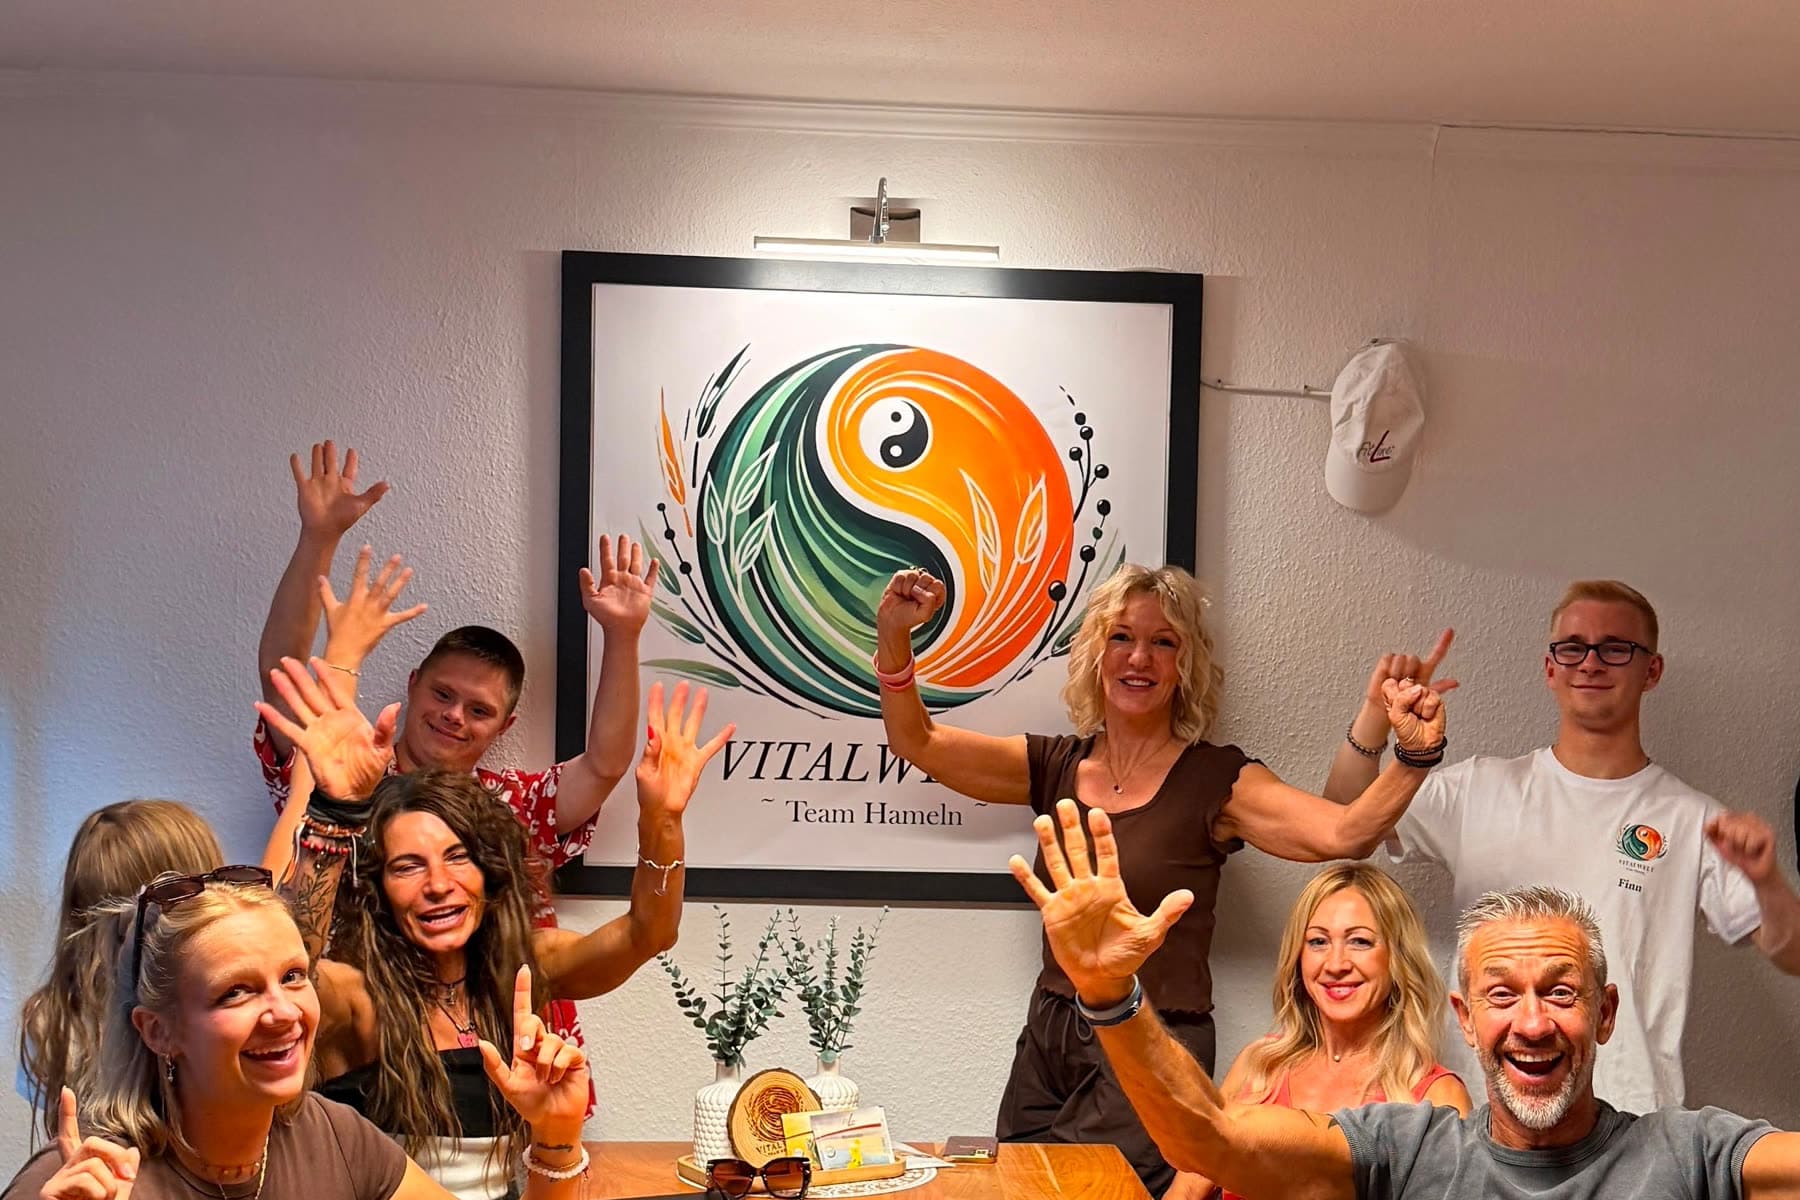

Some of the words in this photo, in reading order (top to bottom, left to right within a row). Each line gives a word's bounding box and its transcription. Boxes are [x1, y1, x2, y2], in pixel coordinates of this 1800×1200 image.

[723, 740, 939, 784] VITALW
[785, 800, 855, 824] Team
[864, 802, 963, 826] Hameln
[1618, 878, 1642, 892] Finn
[755, 1141, 785, 1155] VITAL
